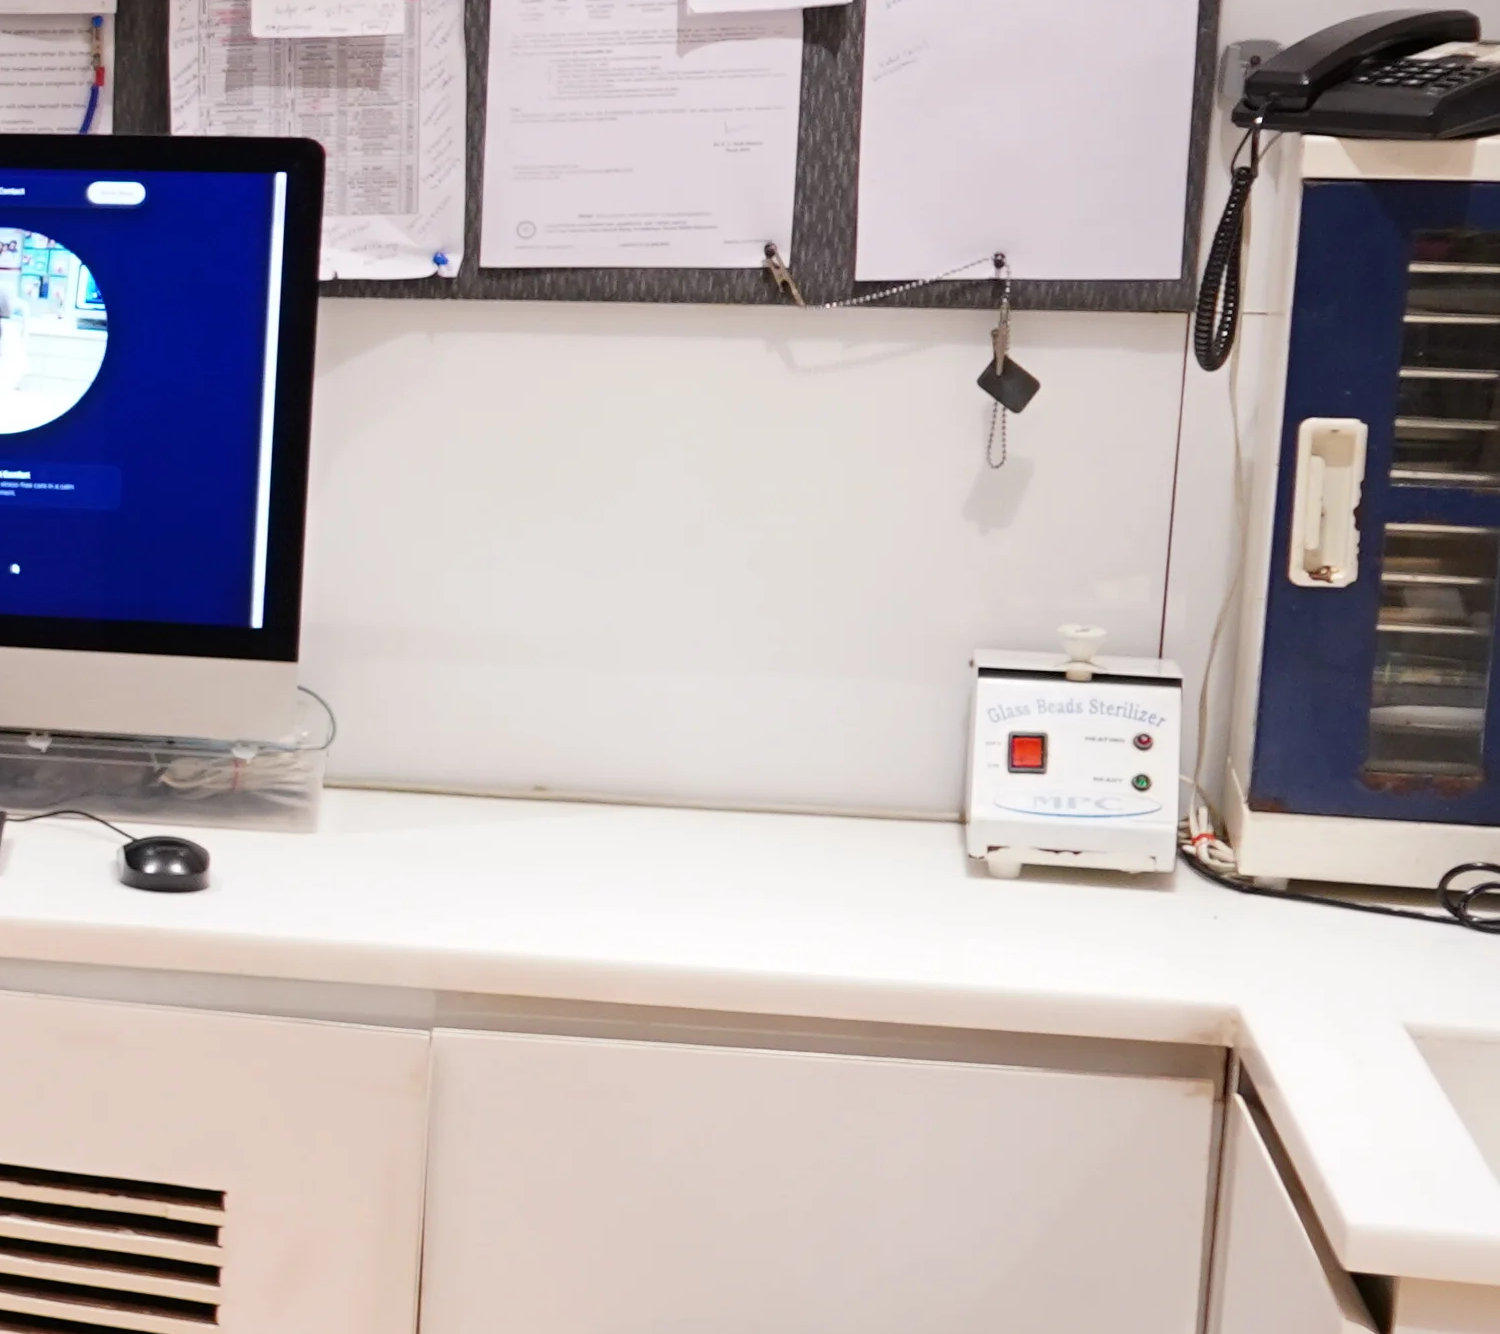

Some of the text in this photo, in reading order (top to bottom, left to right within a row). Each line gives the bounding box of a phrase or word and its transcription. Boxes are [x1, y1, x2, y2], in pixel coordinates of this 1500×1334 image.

[987, 698, 1166, 727] Glass Beads Sterilizer
[1034, 796, 1123, 811] MPC
